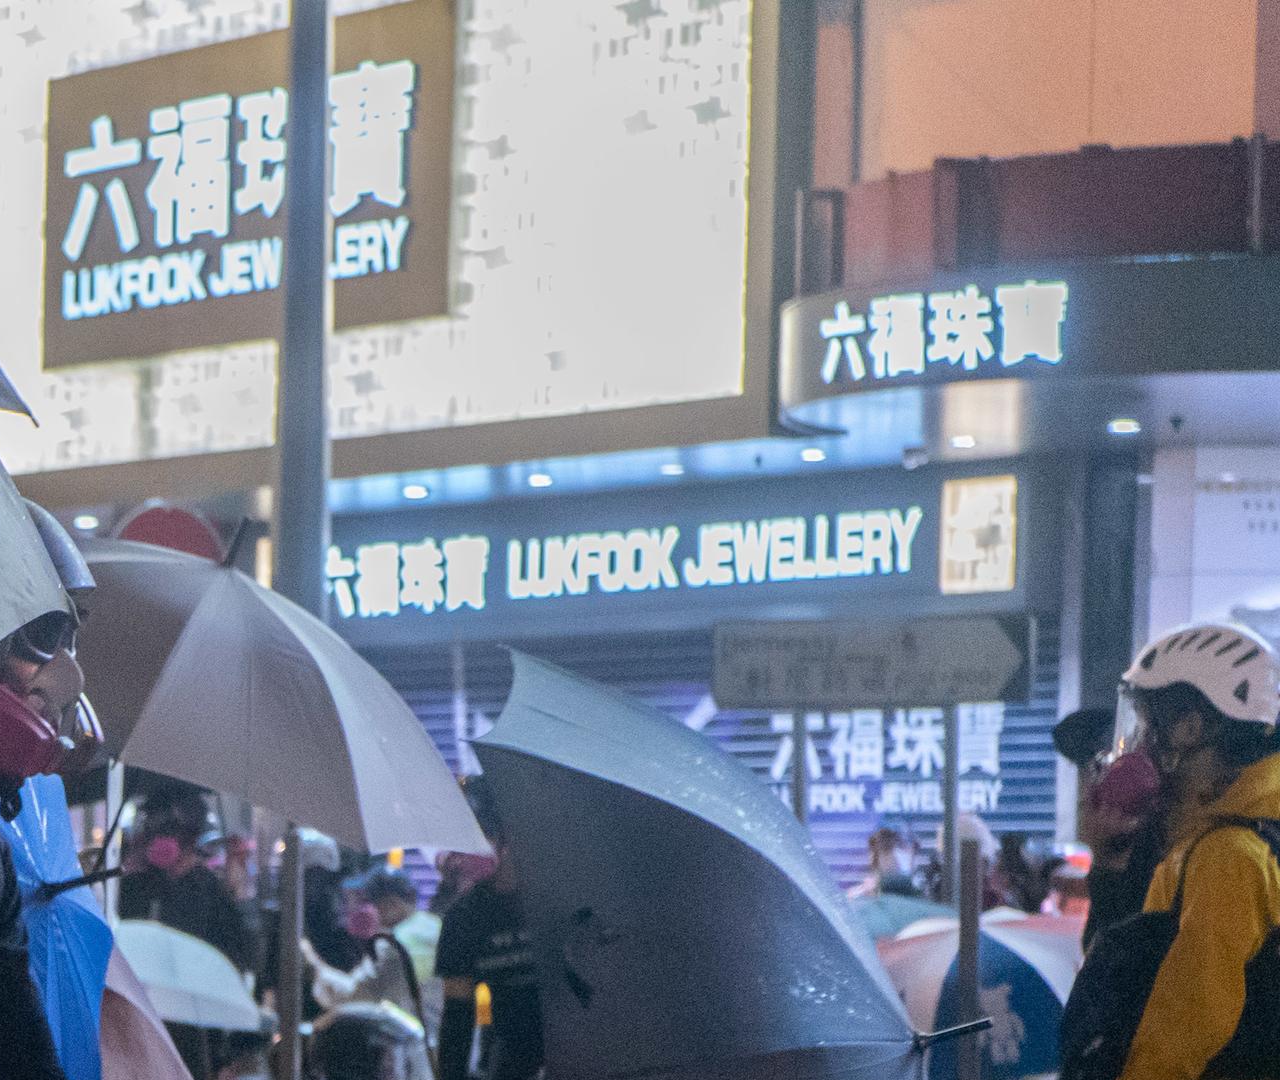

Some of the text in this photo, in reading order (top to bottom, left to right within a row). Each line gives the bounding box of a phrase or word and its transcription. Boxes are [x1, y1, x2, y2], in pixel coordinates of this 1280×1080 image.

[61, 59, 416, 262] 六福珠寶
[208, 214, 410, 297] JEWERY
[819, 279, 1068, 384] 六福珠寶
[682, 506, 923, 587] JEWELLERY
[770, 702, 1005, 781] 六福珠寶
[873, 779, 1003, 813] JEWELERY
